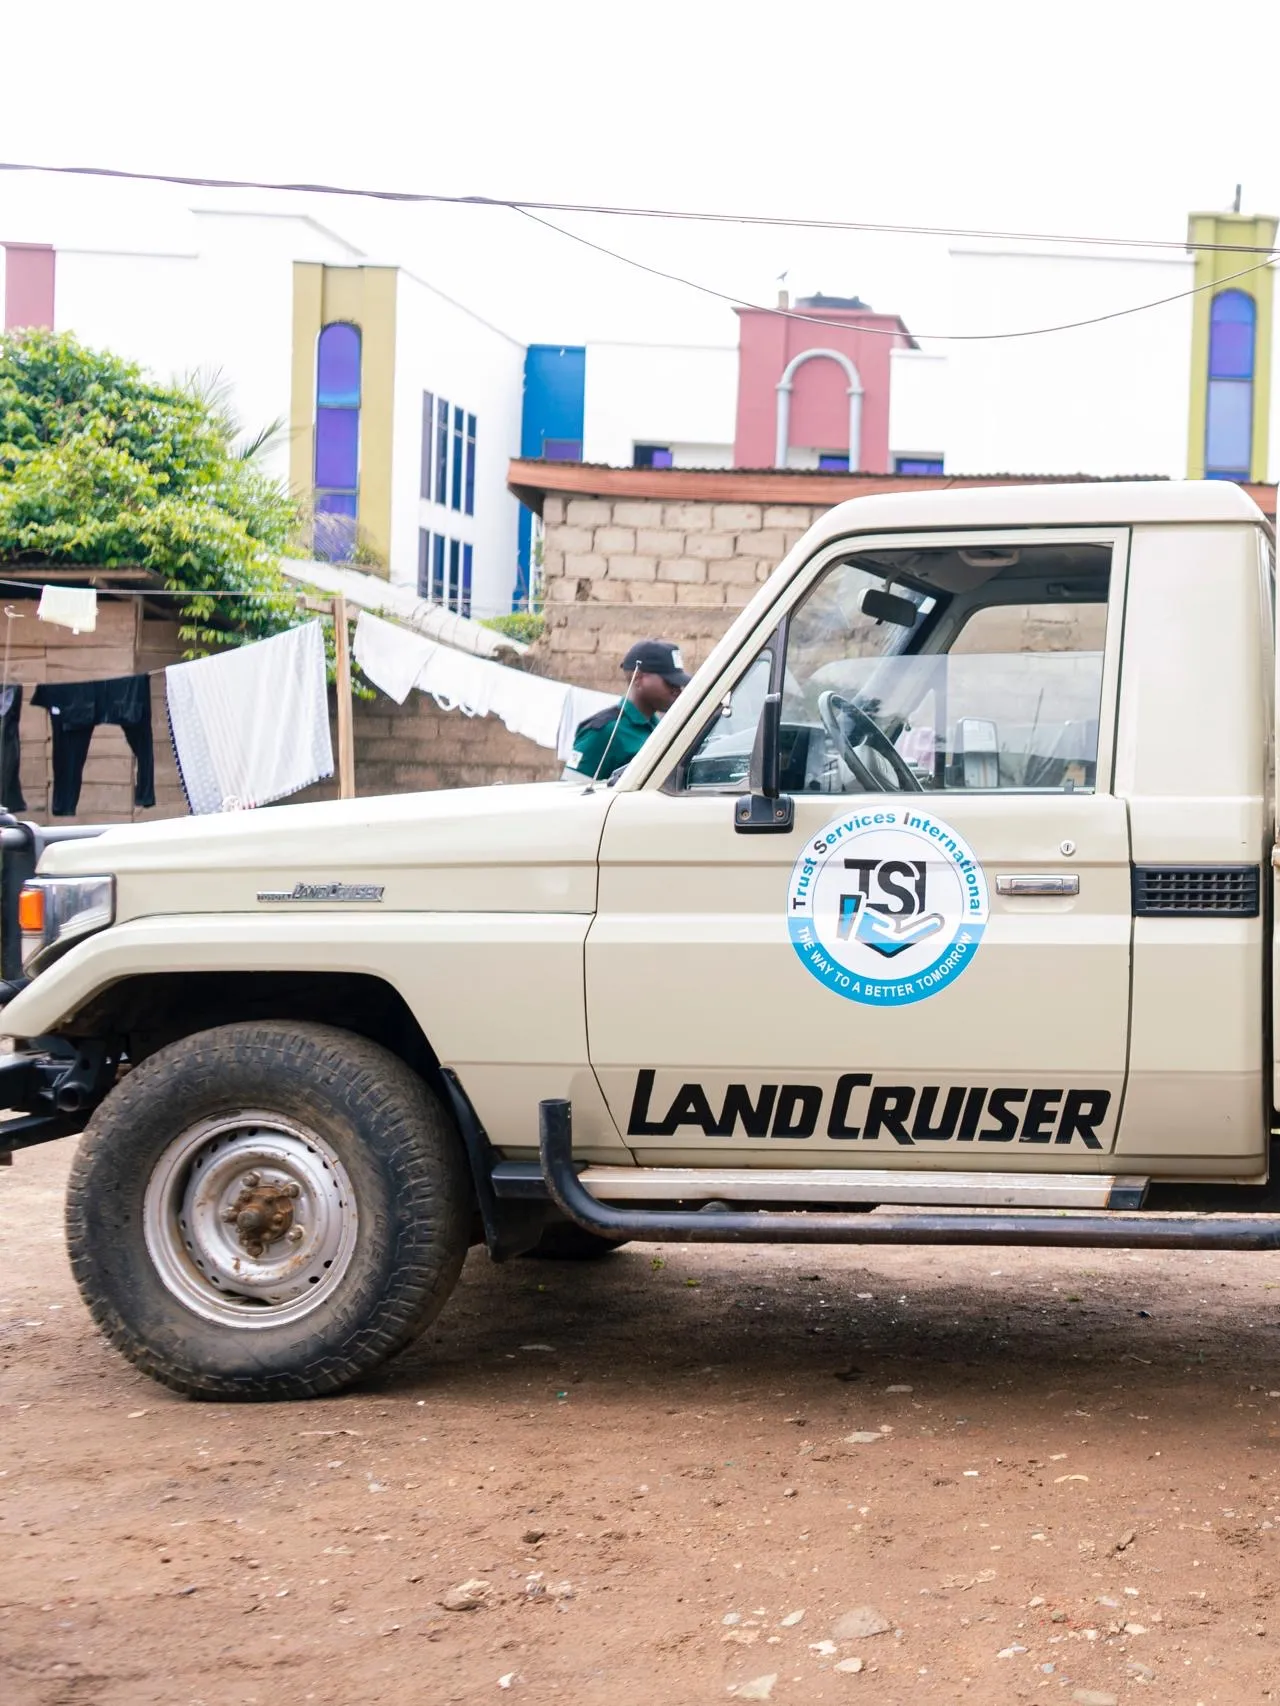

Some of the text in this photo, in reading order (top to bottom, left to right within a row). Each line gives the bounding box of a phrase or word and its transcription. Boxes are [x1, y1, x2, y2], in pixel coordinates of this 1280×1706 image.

[793, 811, 983, 917] Trust Services International
[844, 858, 927, 917] TSI
[797, 927, 972, 998] THE WAY TO A BETTER TOMORROW
